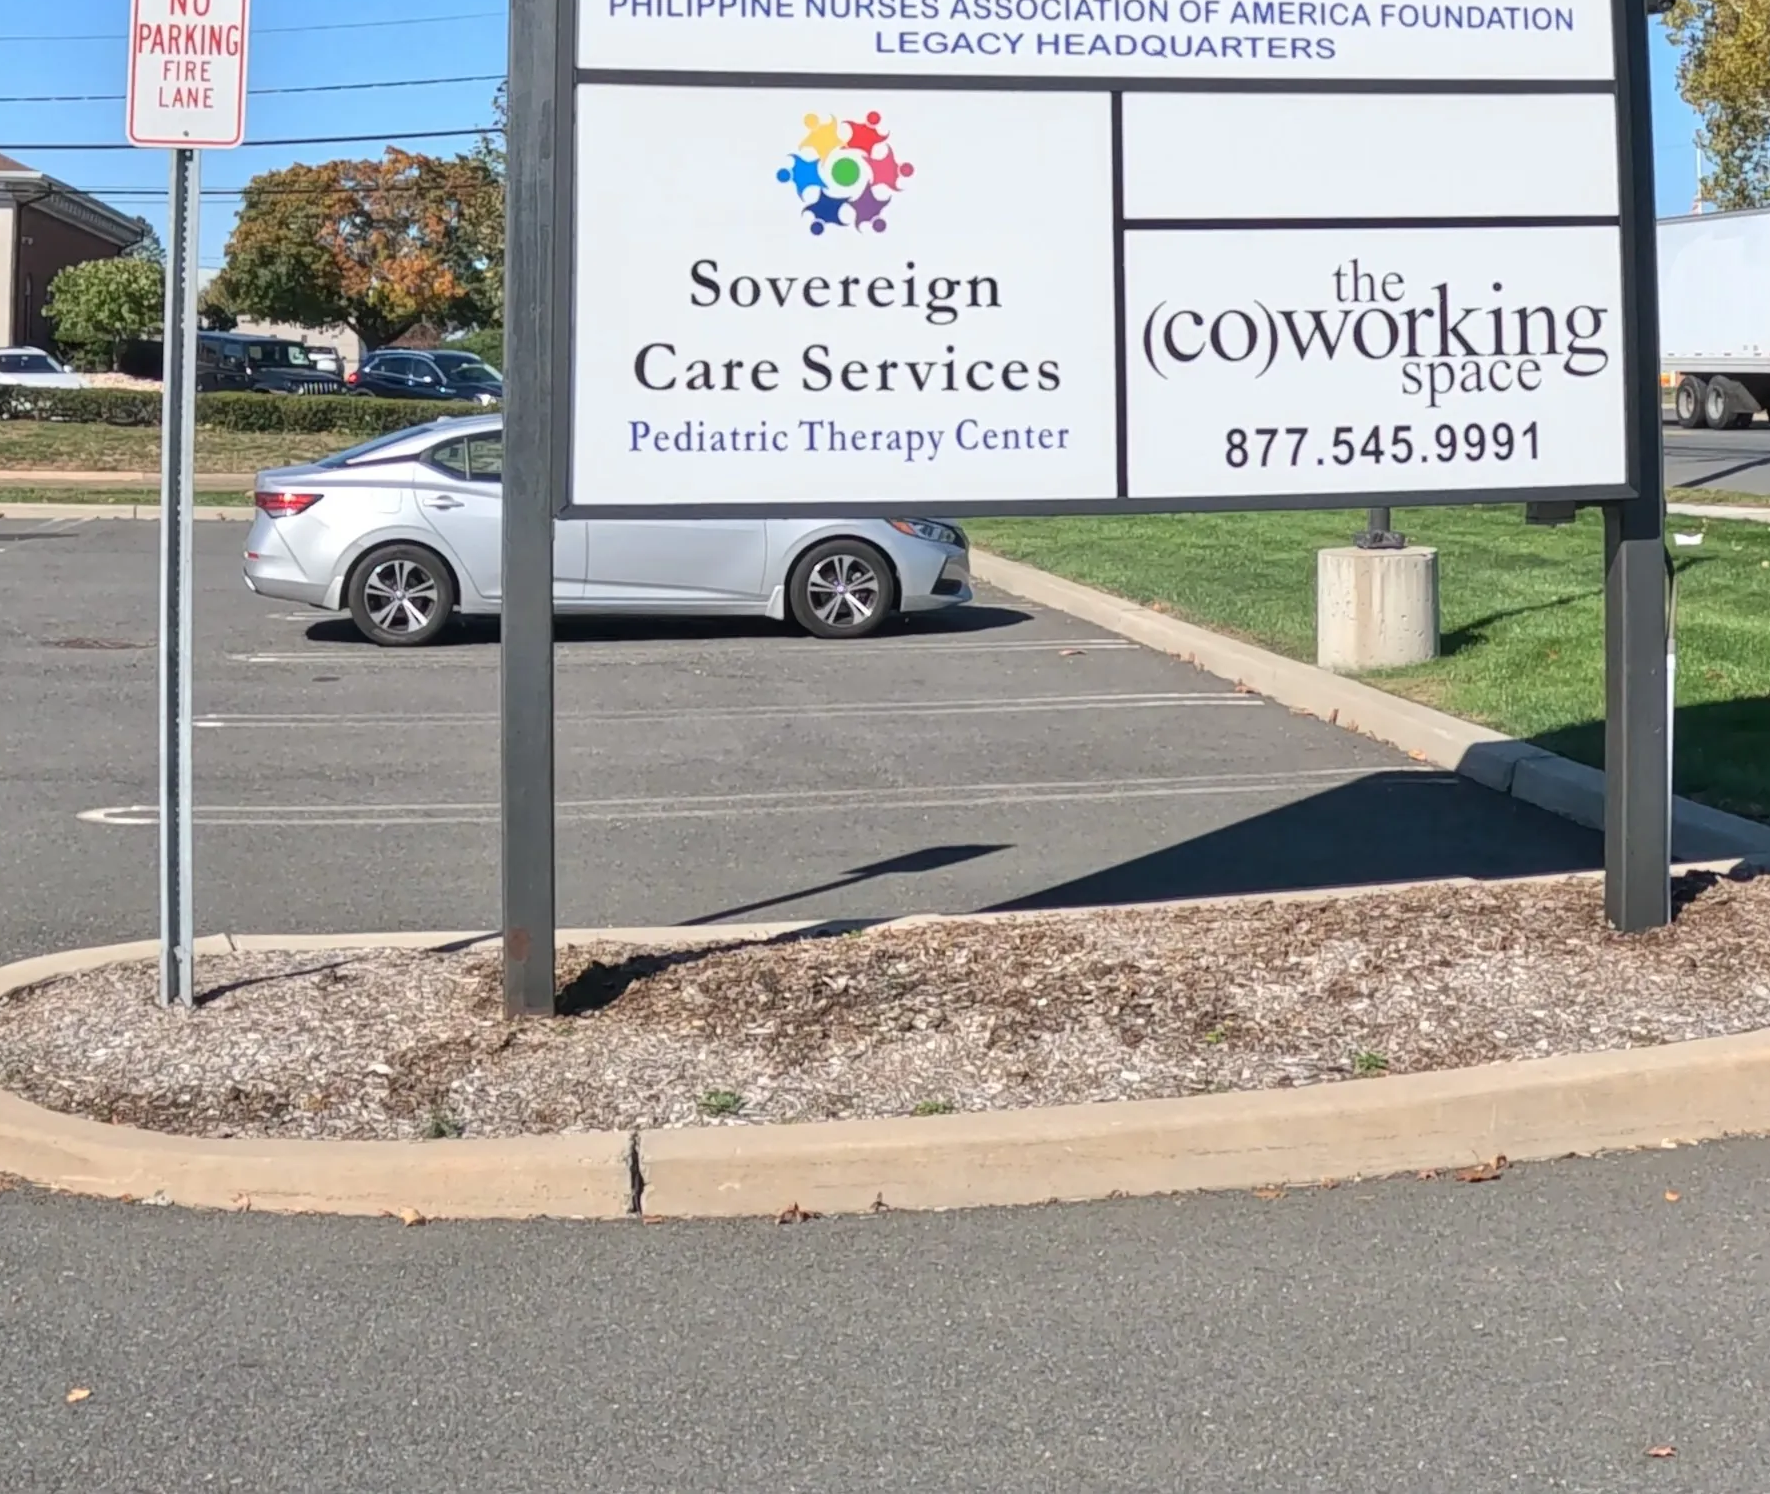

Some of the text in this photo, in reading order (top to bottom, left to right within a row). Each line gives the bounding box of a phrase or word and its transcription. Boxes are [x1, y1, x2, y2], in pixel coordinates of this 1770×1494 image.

[1179, 0, 1220, 23] OF
[1230, 0, 1371, 27] AMERICA
[1381, 4, 1574, 31] FOUNDATION
[138, 23, 240, 57] PARKING
[876, 31, 1336, 60] LEGACY HEADQUARTERS
[163, 60, 212, 83] FIRE
[158, 87, 214, 109] LANE
[690, 259, 1002, 325] Sovereign
[1333, 258, 1404, 303] the
[634, 342, 1060, 392] Care Services
[1400, 357, 1542, 408] space
[629, 418, 1070, 461] Pediatric Therapy Center
[1225, 421, 1538, 468] 877.545.9991
